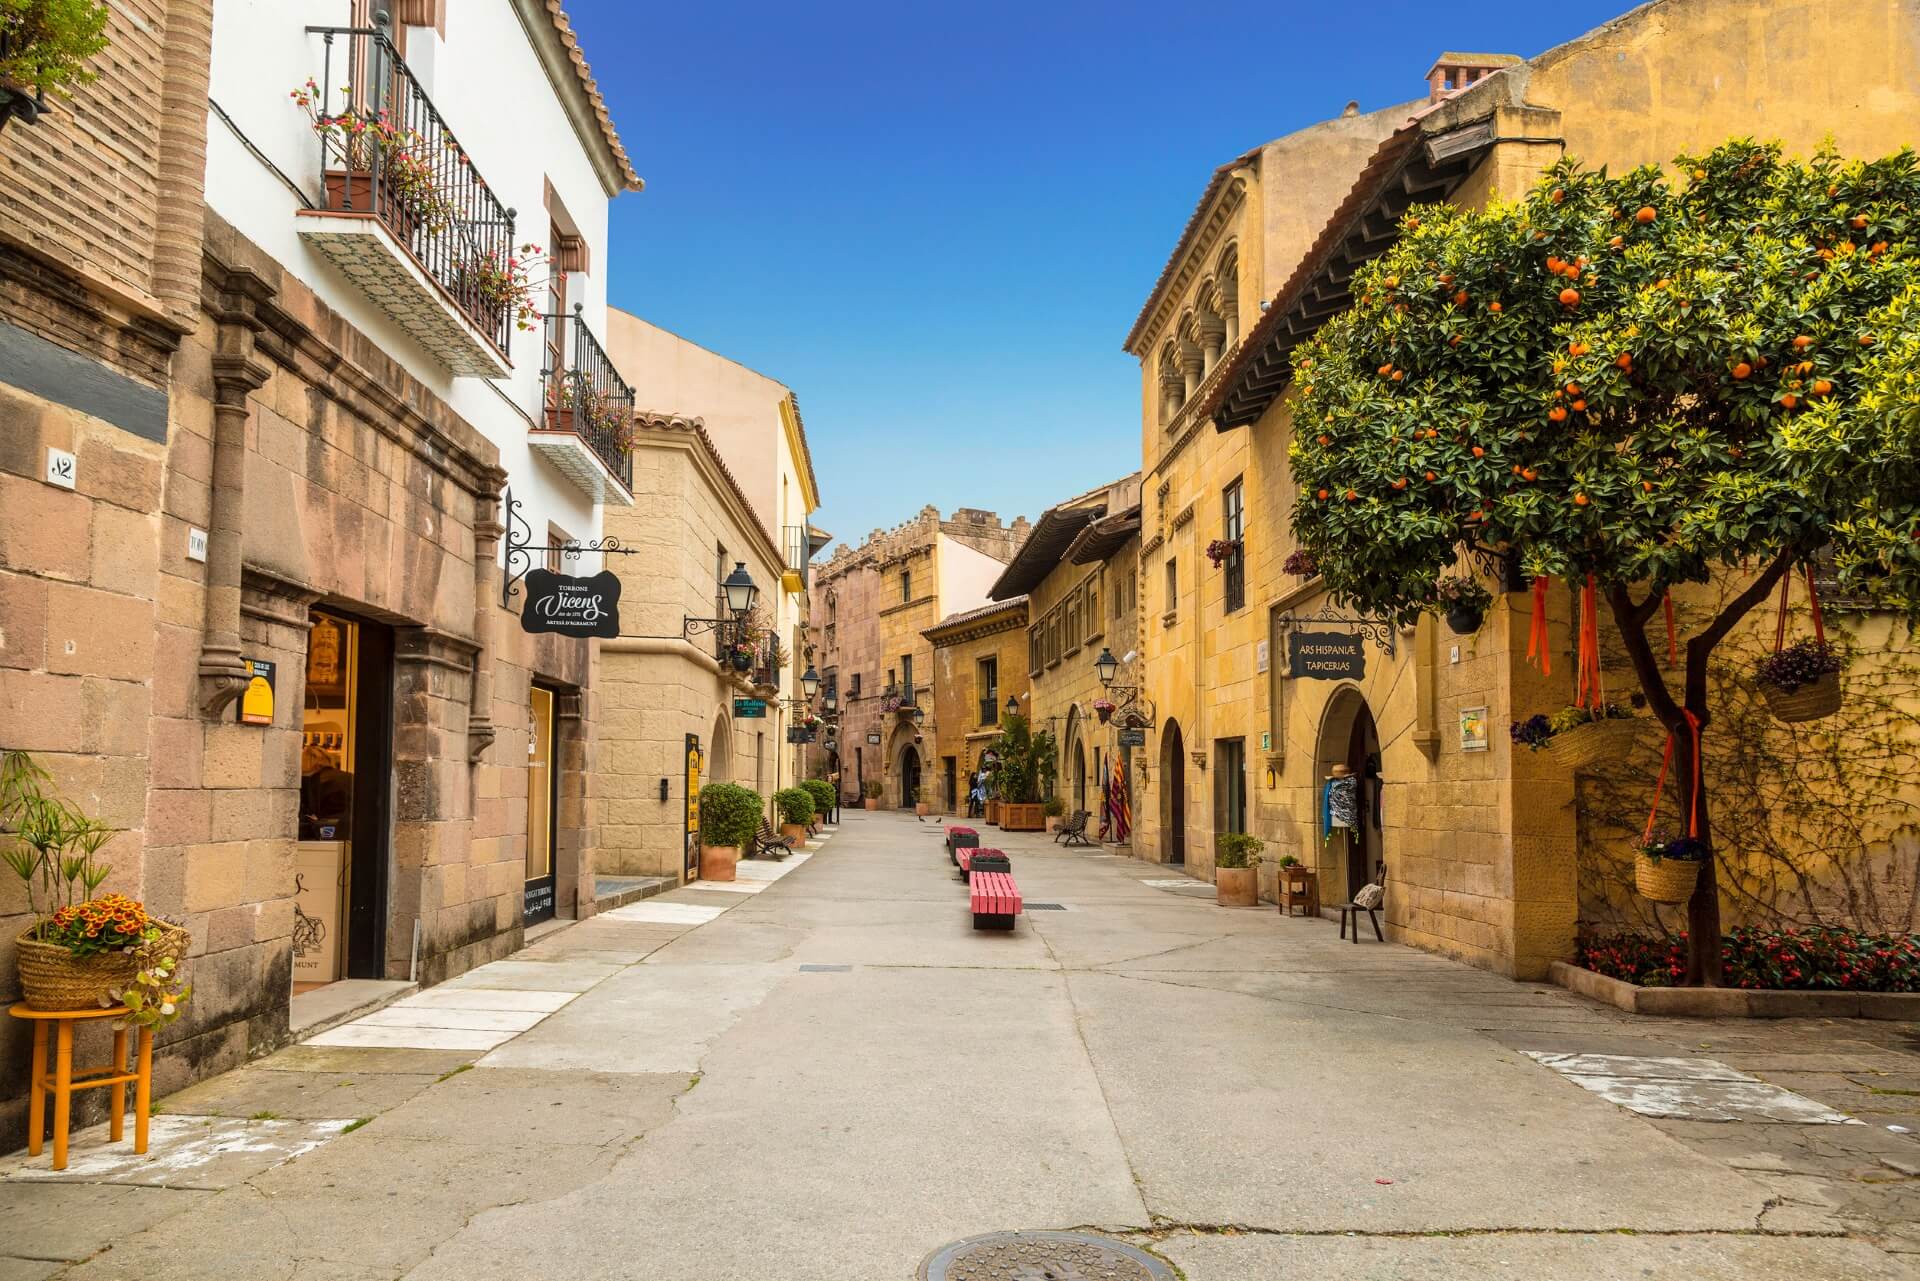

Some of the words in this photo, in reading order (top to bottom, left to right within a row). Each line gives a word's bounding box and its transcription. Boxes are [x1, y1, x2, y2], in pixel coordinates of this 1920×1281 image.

[535, 592, 608, 620] Vicens
[1300, 645, 1314, 655] ARS
[1306, 662, 1350, 671] TAPICERIAS
